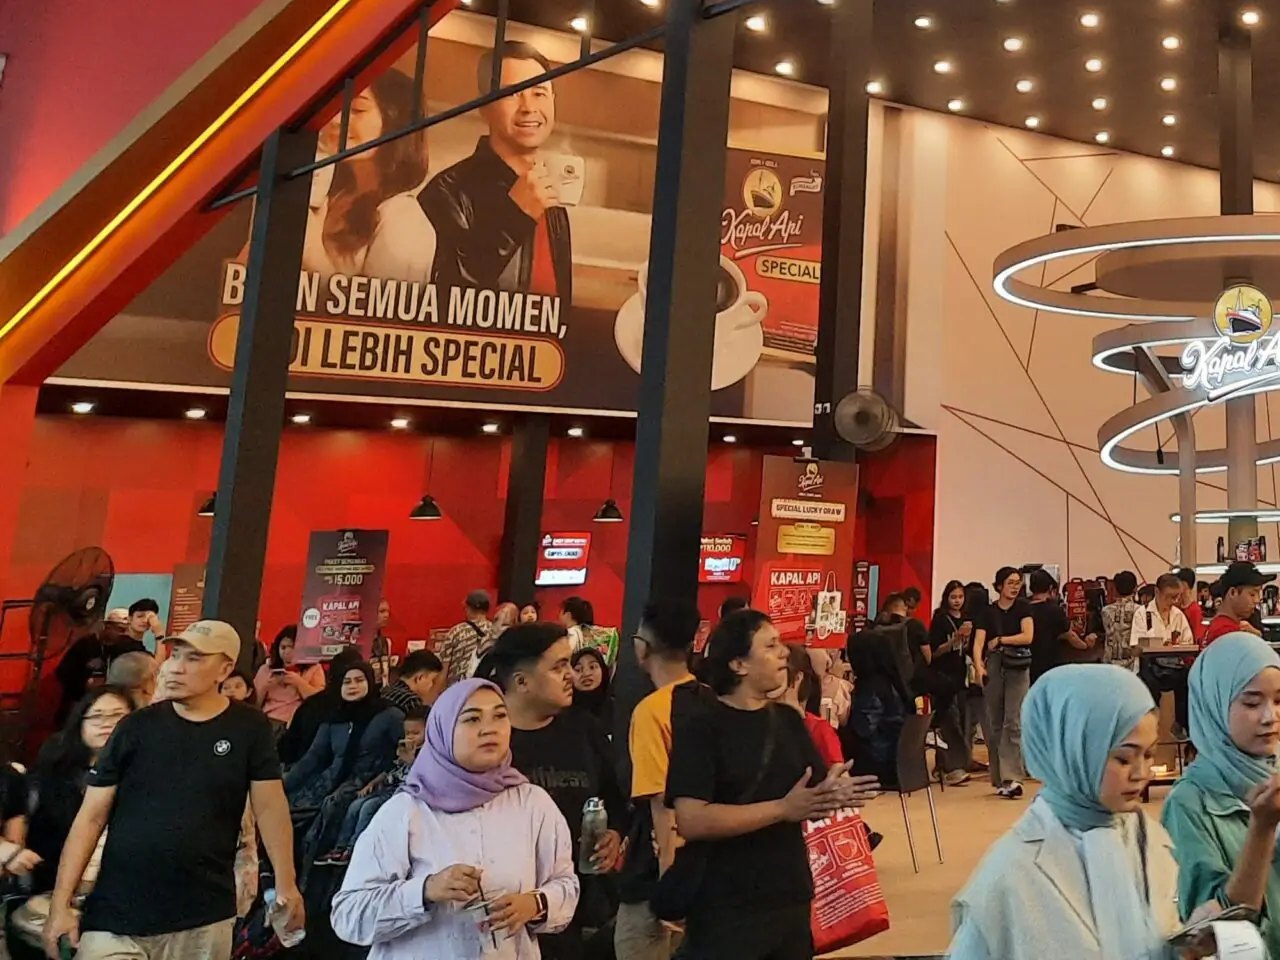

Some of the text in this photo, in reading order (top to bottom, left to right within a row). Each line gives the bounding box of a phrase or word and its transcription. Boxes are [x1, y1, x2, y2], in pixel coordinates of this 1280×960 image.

[720, 208, 804, 250] Kapal Api
[761, 259, 820, 280] SPECIAL
[326, 274, 440, 324] SEMUA
[447, 285, 568, 339] MOMEN,
[320, 328, 416, 375] LEBIH
[420, 336, 543, 383] SPECIAL
[1180, 336, 1258, 390] Kapal
[776, 504, 842, 515] SPECIAL LUCKY DRAW
[334, 574, 363, 585] 15.000
[770, 571, 804, 585] KAPAL
[322, 601, 347, 611] KAPAL
